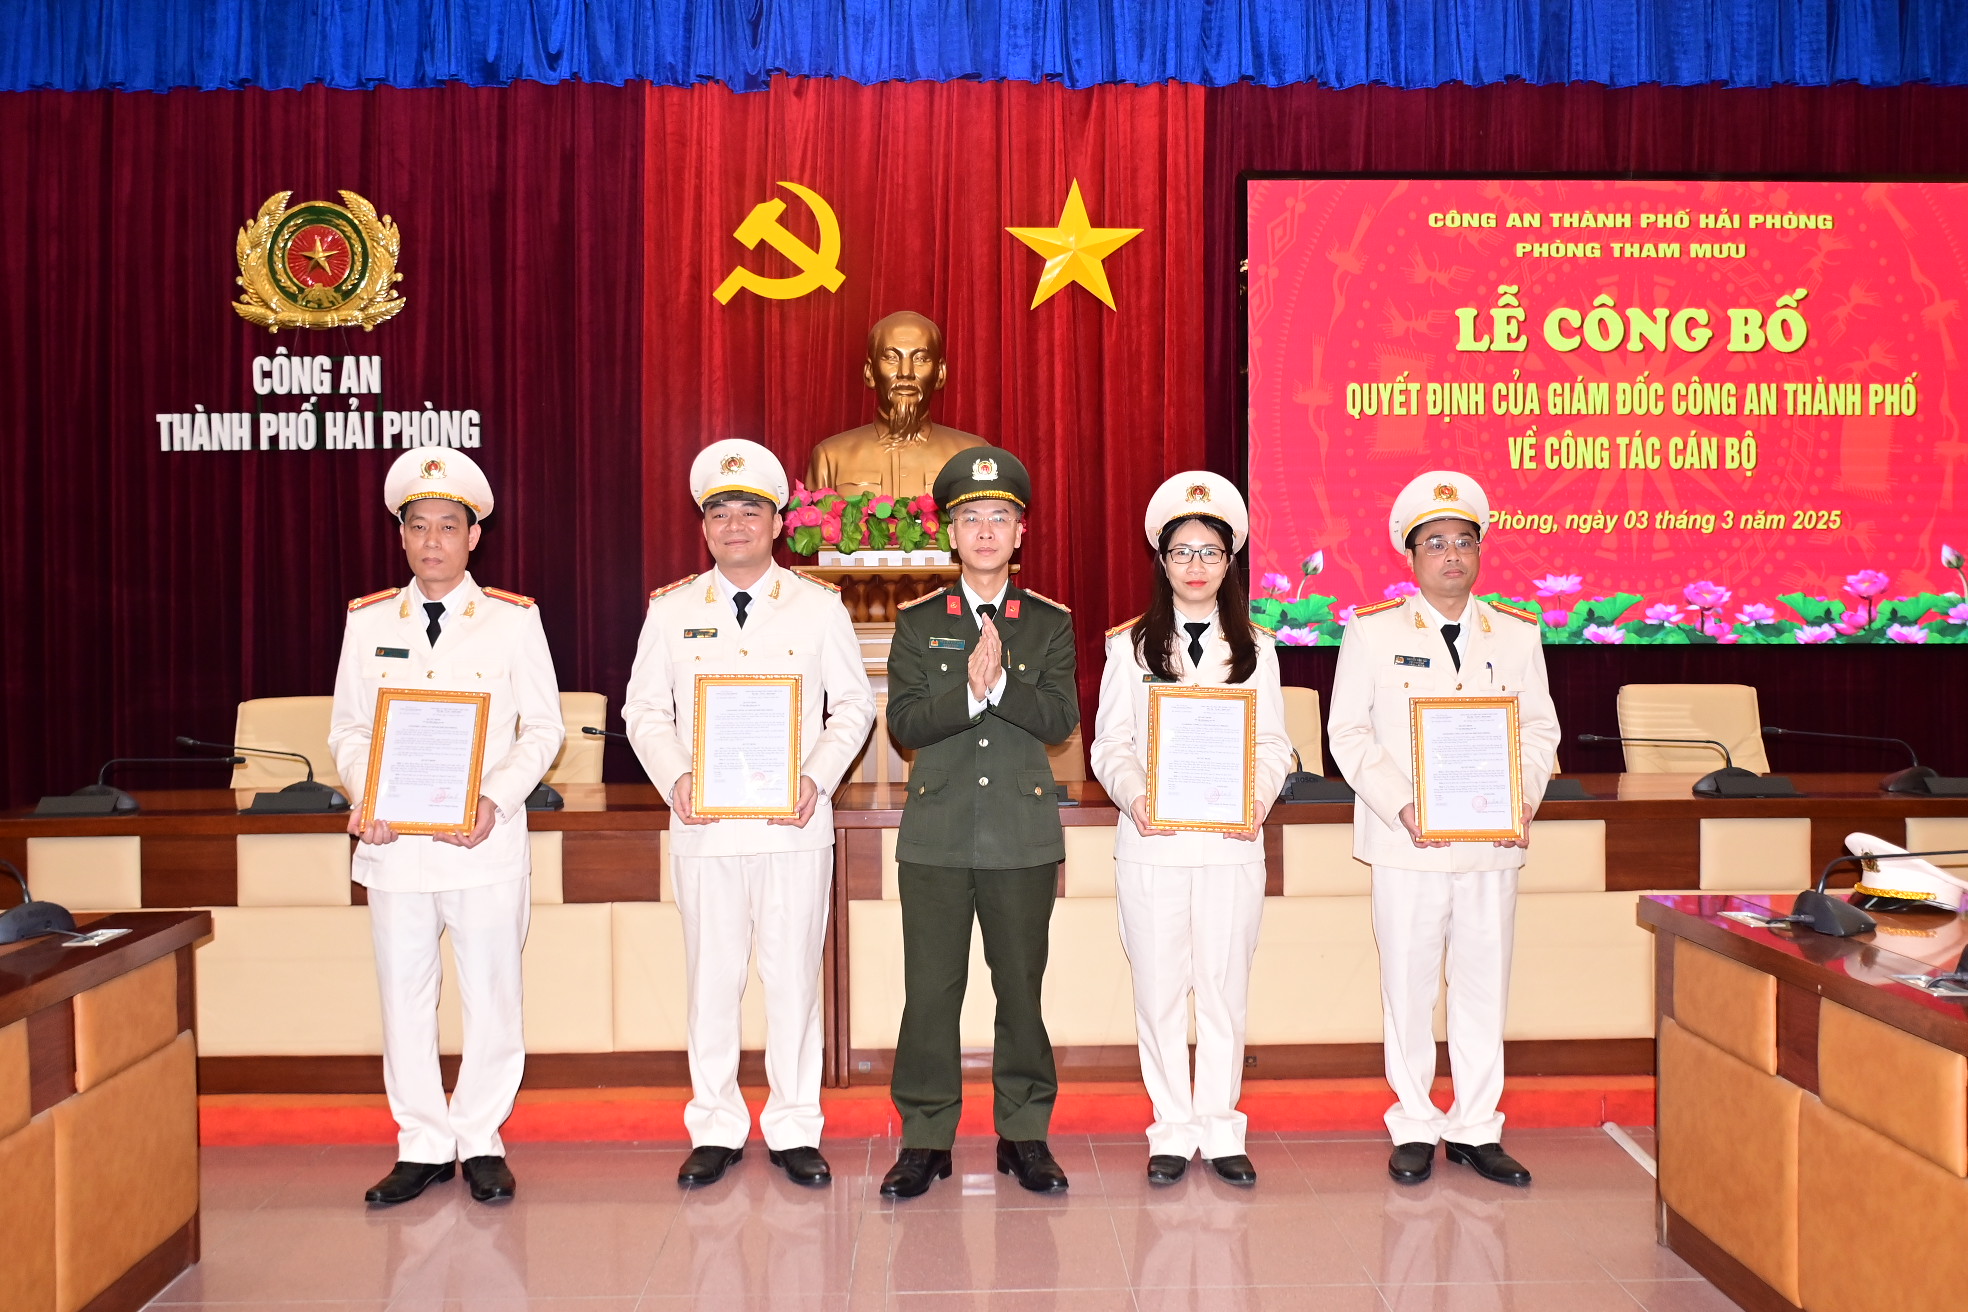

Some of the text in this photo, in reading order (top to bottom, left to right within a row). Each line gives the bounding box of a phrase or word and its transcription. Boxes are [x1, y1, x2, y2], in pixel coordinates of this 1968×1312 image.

[1428, 208, 1833, 230] CÔNG AN THÀNH PHỐ HẢI PHÒNG
[1516, 239, 1747, 259] PHÒNG THAM MƯU
[1455, 284, 1809, 353] LỄ CÔNG BỐ
[252, 346, 382, 395] CÔNG AN
[1346, 369, 1919, 425] QUYẾT ĐỊNH CỦA GIÁM ĐỐC CÔNG AN THÀNH PHỐ
[156, 396, 481, 451] THÀNH PHỐ HẢI PHÒNG
[1508, 425, 1757, 477] VỀ CÔNG TÁC CÁN BỘ
[1564, 510, 1618, 534] ngày
[1623, 510, 1649, 530] 03
[1655, 510, 1716, 534] tháng
[1721, 510, 1734, 530] 3
[1740, 511, 1786, 530] năm
[1791, 510, 1842, 530] 2025
